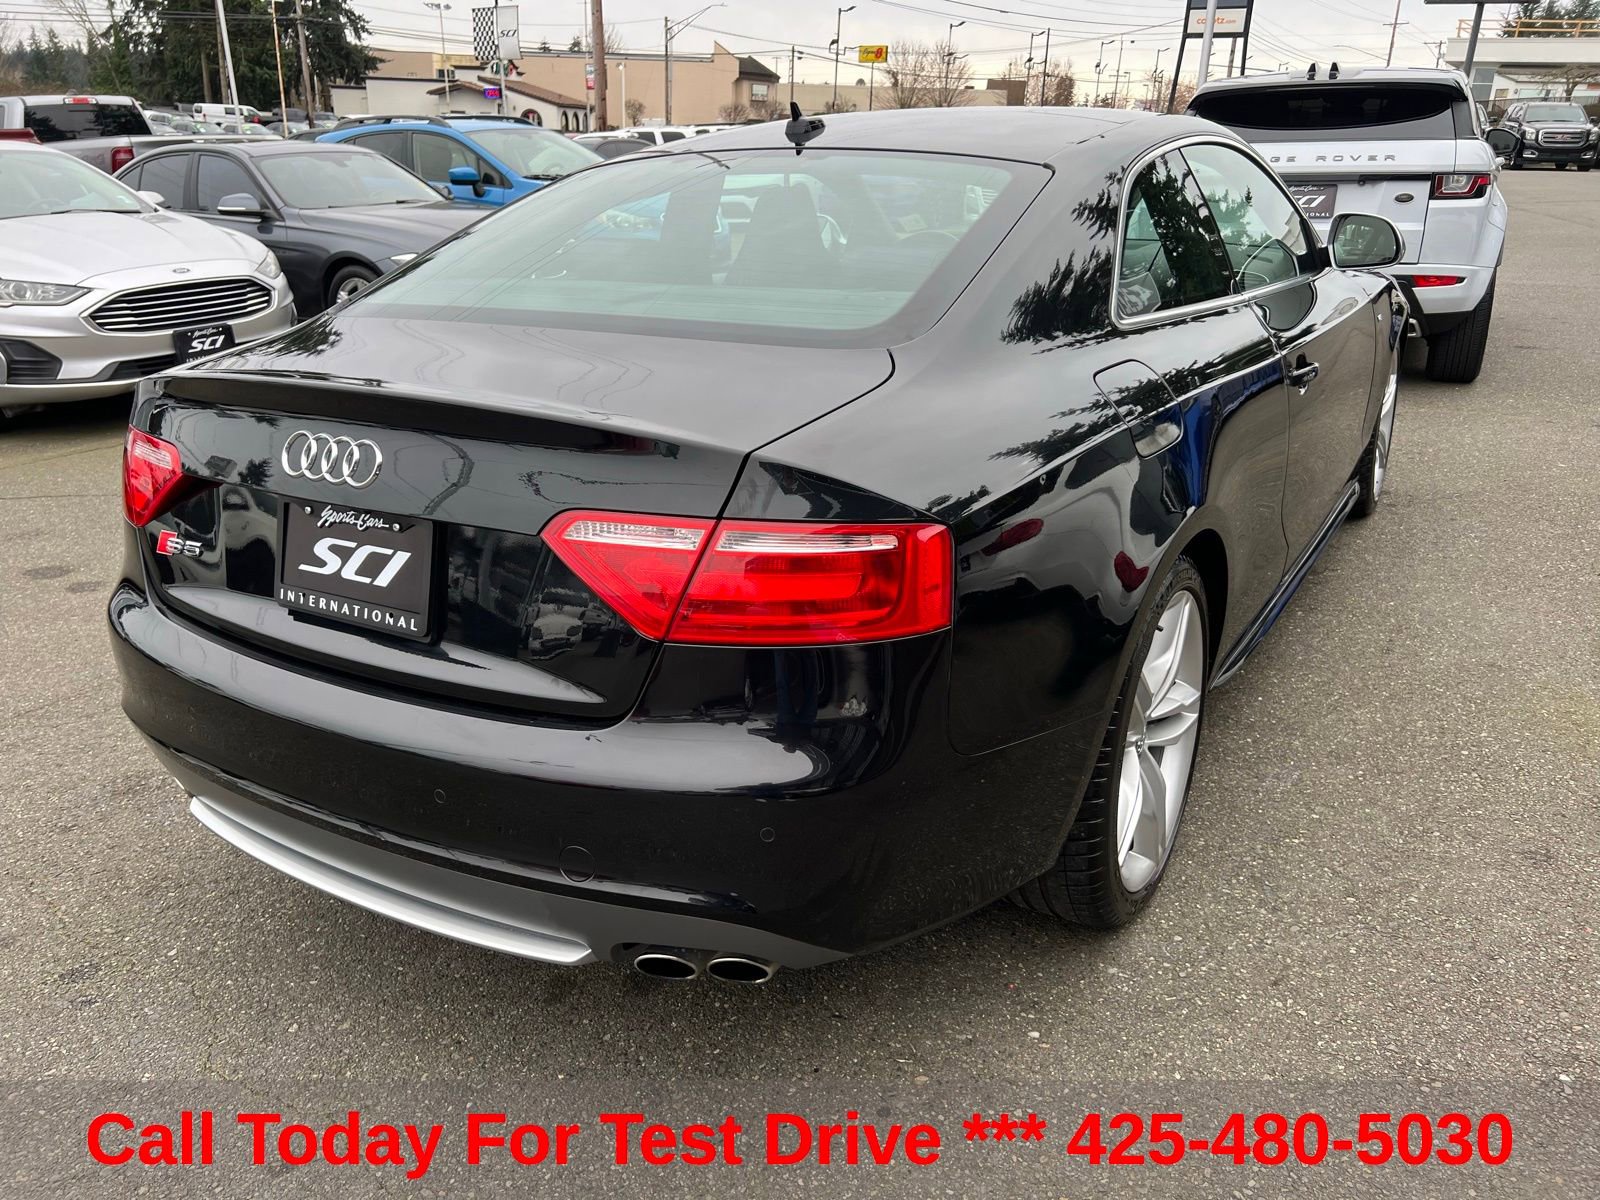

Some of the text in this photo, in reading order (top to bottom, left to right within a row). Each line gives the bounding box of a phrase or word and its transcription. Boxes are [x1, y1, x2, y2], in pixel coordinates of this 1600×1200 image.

[500, 29, 517, 38] SCI
[1315, 154, 1396, 162] ROVER
[187, 334, 226, 353] SCI
[317, 504, 390, 531] Sports Cars
[166, 537, 203, 558] S5
[298, 537, 412, 588] SCI
[280, 588, 418, 631] INTERNATIONAL
